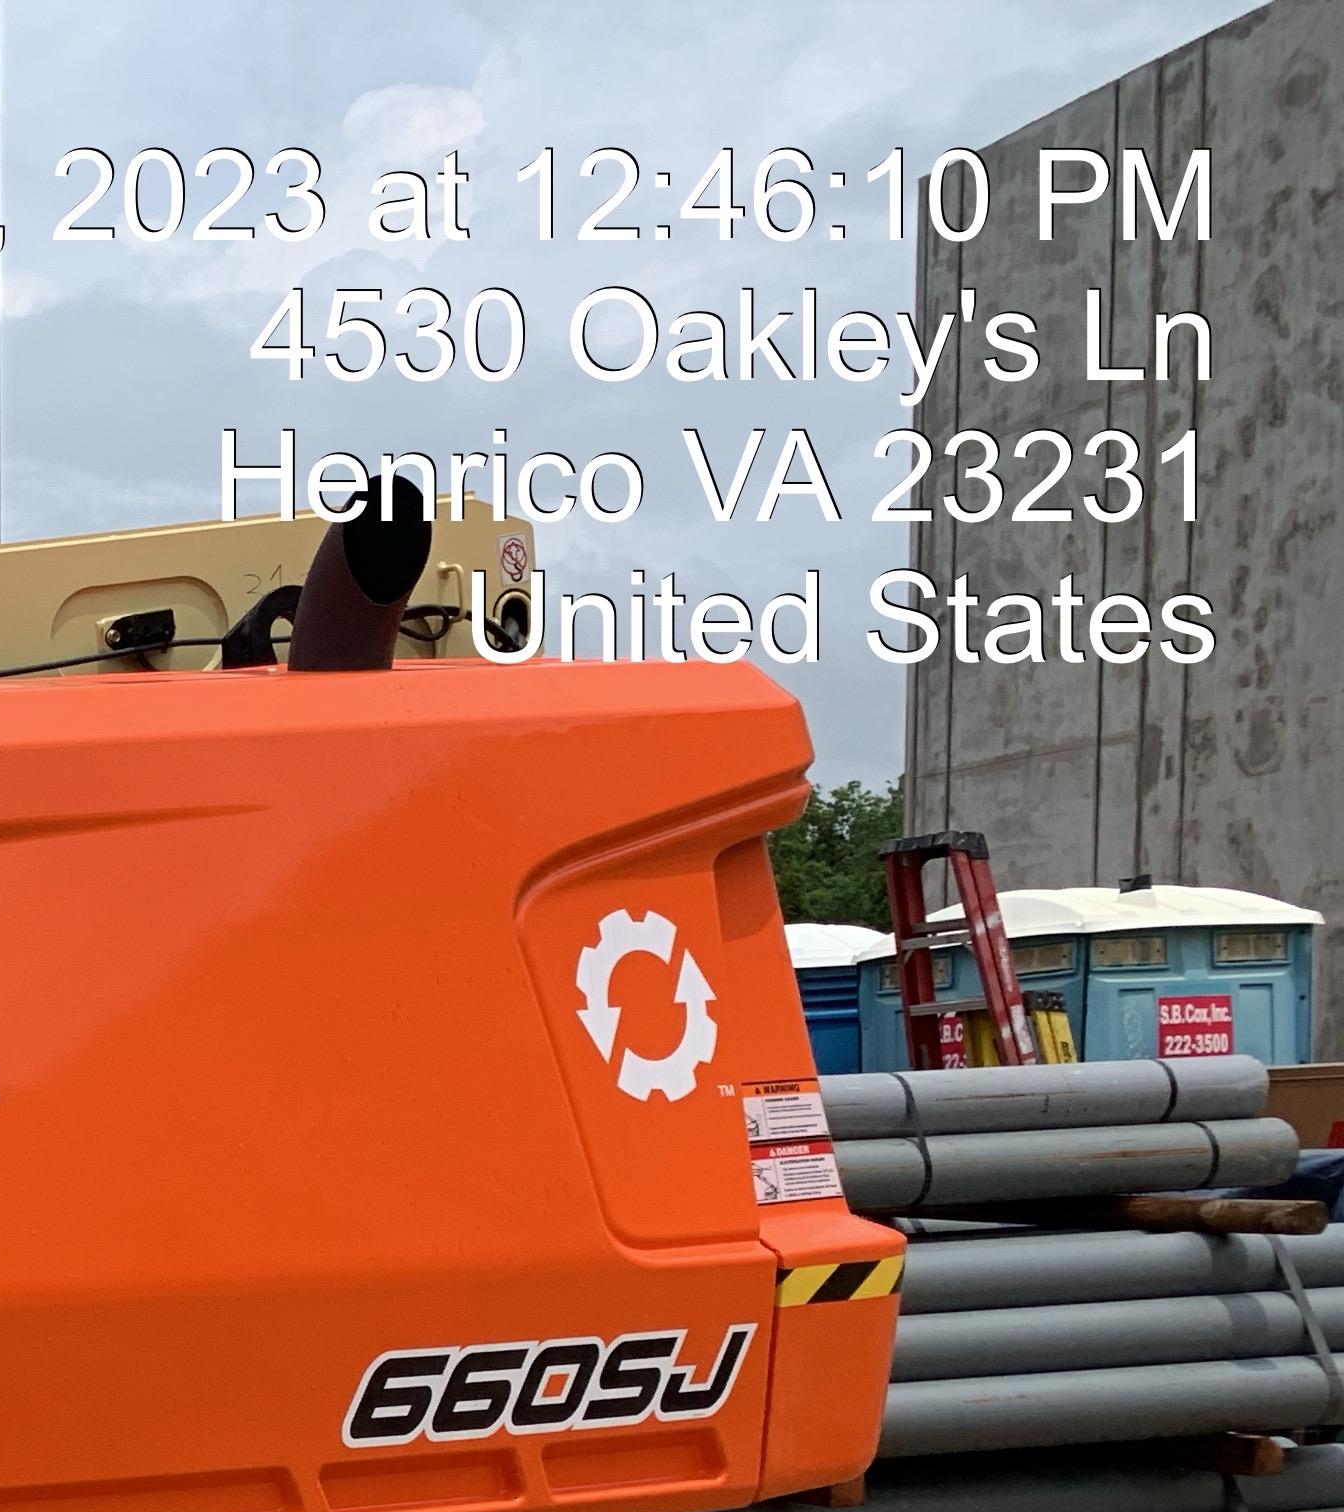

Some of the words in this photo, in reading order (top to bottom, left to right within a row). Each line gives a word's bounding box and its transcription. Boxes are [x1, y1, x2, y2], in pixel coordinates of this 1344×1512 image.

[1164, 1032, 1229, 1056] 222-3500
[776, 1145, 810, 1156] DANGER
[345, 1327, 752, 1443] 660SJ
